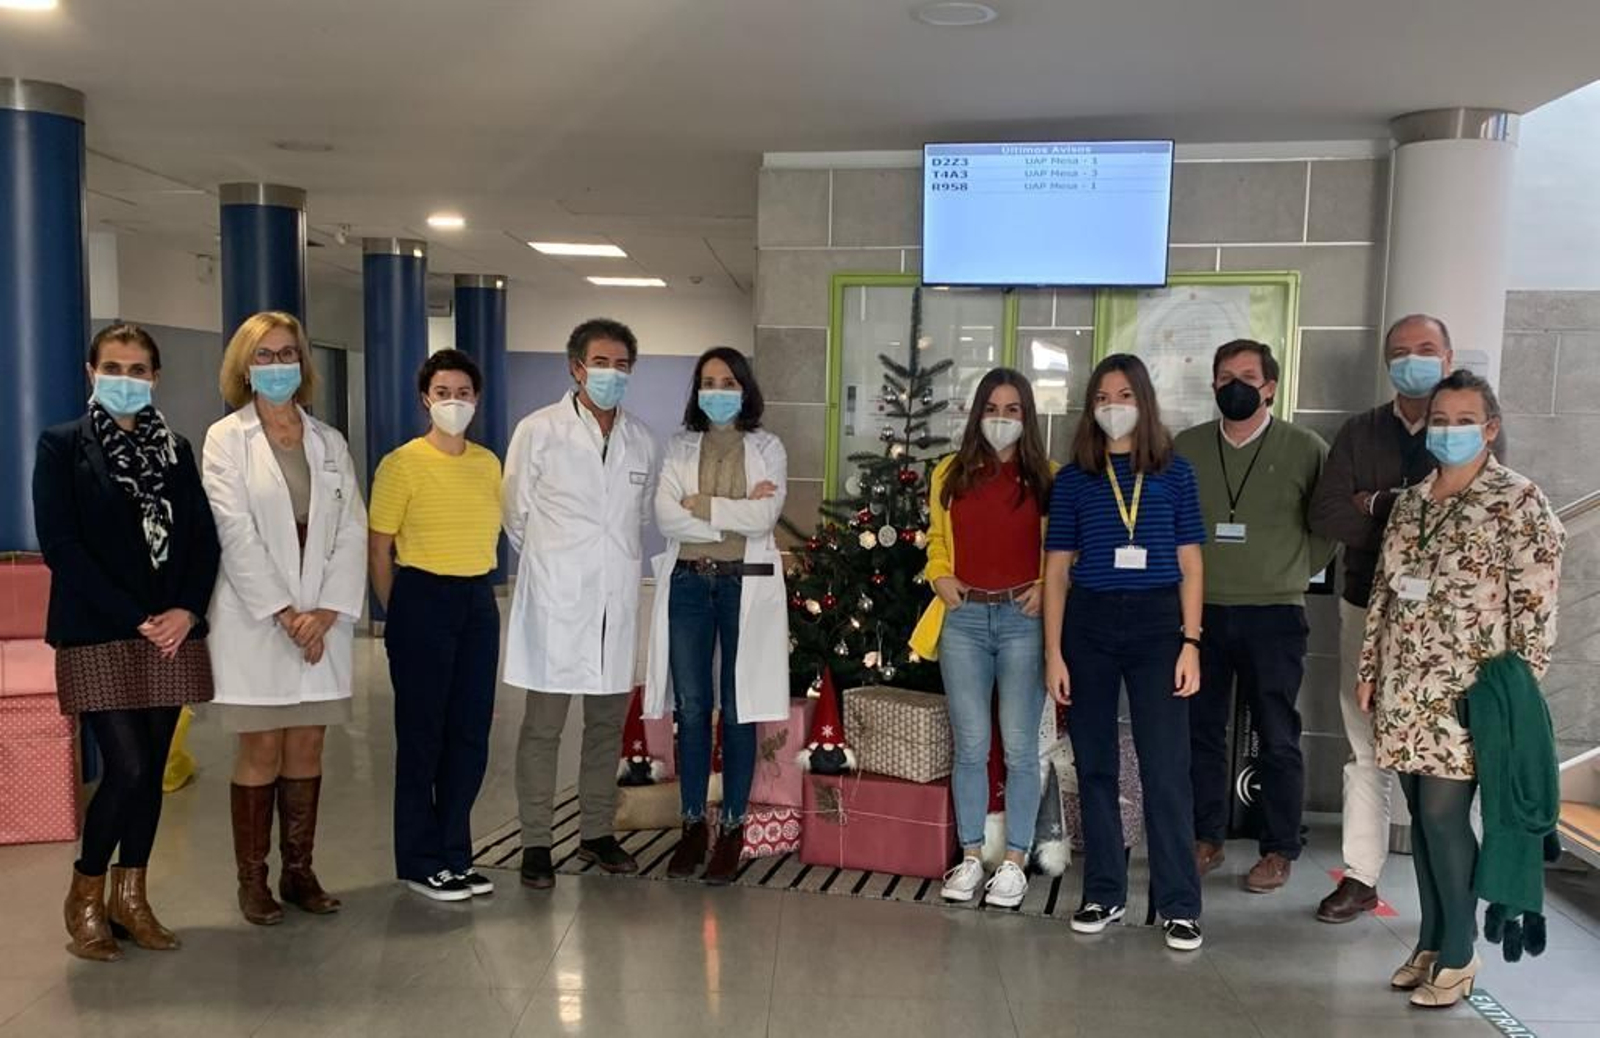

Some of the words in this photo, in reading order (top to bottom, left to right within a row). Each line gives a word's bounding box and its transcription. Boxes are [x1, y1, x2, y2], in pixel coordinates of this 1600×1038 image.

[931, 158, 969, 166] D2Z3
[932, 170, 968, 178] T4A3
[931, 183, 968, 191] R958
